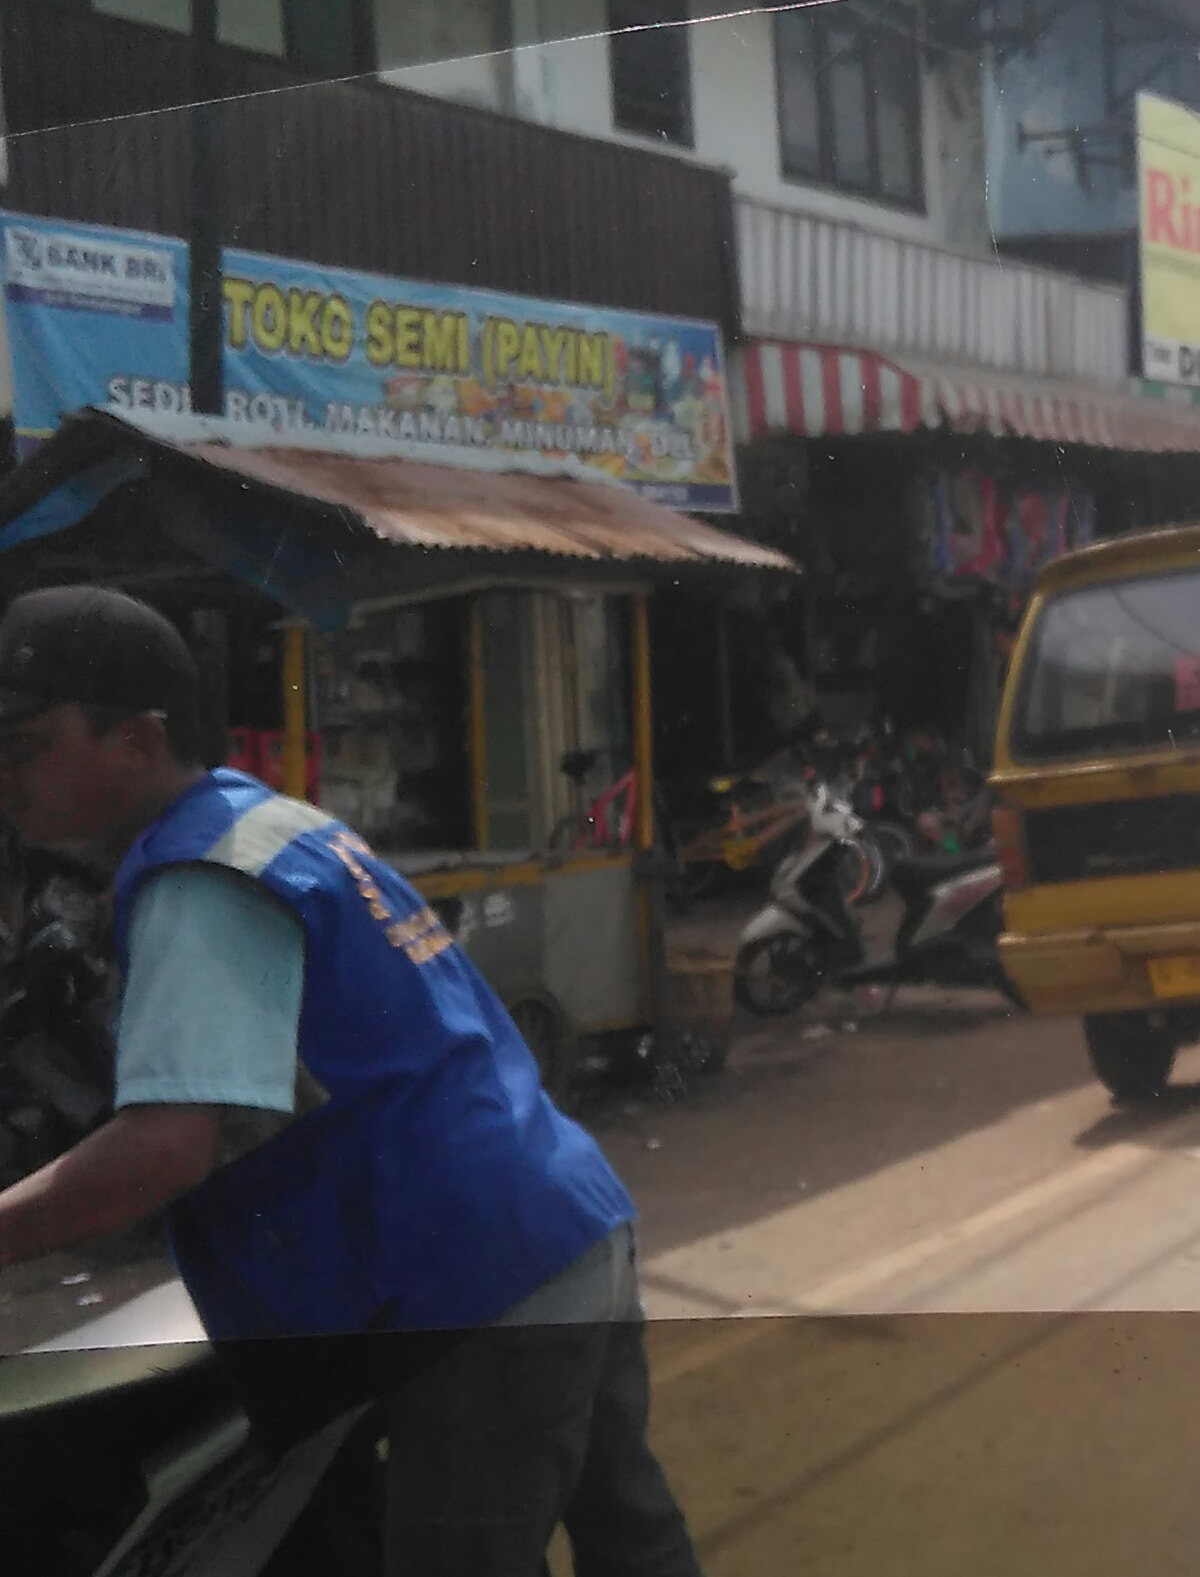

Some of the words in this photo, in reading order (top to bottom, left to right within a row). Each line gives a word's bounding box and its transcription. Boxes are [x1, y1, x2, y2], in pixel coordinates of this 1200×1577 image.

[47, 245, 117, 274] BANK
[222, 278, 354, 361] TOKO
[365, 301, 470, 374] SEMI
